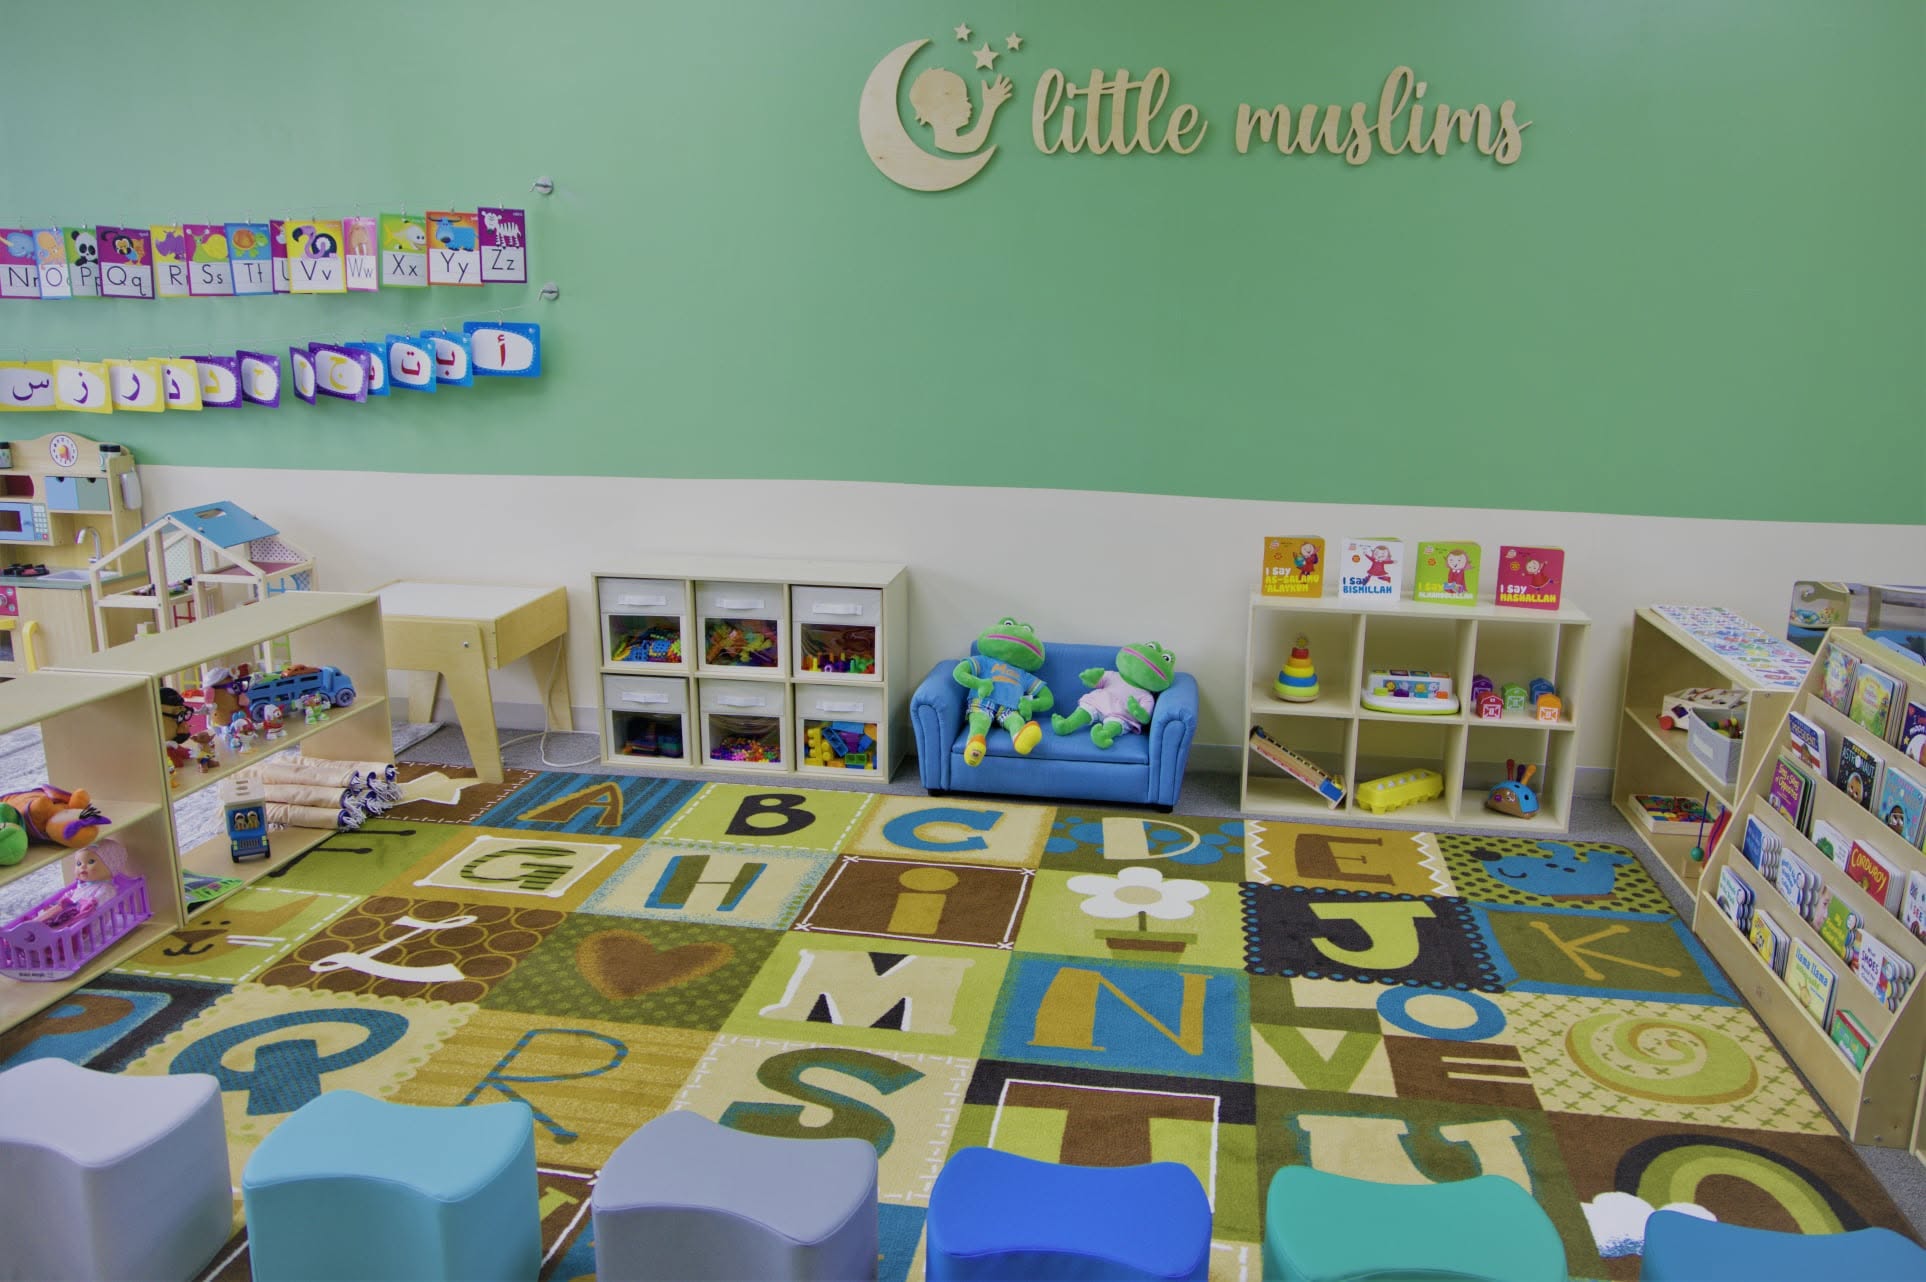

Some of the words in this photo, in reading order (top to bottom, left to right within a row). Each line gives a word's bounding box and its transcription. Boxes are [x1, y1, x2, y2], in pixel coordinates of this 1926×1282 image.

[1030, 67, 1209, 155] little
[1234, 65, 1533, 166] muslims
[45, 267, 71, 287] O
[106, 265, 147, 297] Qq
[168, 264, 188, 286] R
[201, 263, 224, 285] Ss
[243, 262, 264, 283] Tt
[300, 260, 332, 281] Vv
[347, 257, 374, 278] Ww
[391, 253, 419, 277] Xx
[440, 251, 470, 283] Yy
[490, 248, 516, 271] Zz
[1343, 585, 1393, 594] BISMILLAH
[518, 782, 623, 827] A
[725, 793, 816, 836] B
[883, 807, 1004, 852] C
[1102, 817, 1200, 860] D
[460, 846, 577, 890] G
[1294, 833, 1395, 886] E
[1851, 848, 1888, 894] CORDUROY
[644, 854, 767, 911] H
[1308, 901, 1437, 970] J
[1529, 921, 1681, 981] K
[759, 949, 975, 1036] M
[1026, 967, 1213, 1055] N
[456, 1027, 628, 1140] R
[718, 1047, 926, 1160] S
[1002, 1081, 1219, 1168] T
